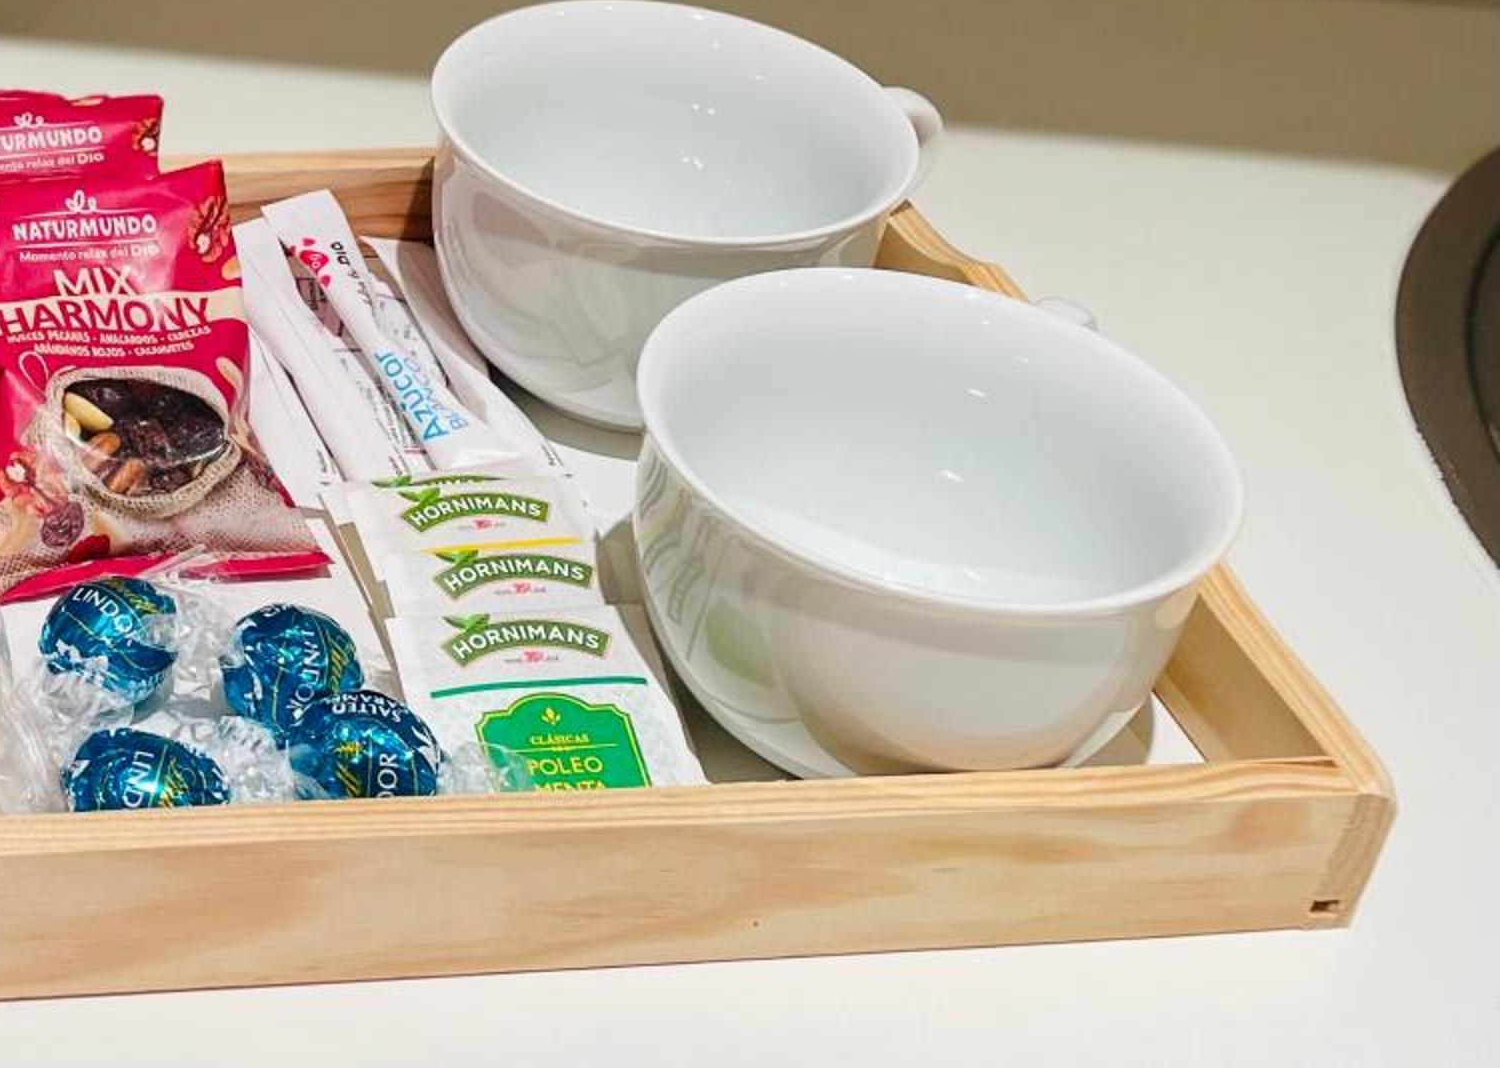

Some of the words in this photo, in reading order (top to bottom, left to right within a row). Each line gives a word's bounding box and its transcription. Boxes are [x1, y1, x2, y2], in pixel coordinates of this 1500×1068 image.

[12, 215, 157, 241] NATURMUNDO
[20, 250, 76, 263] Momento
[78, 248, 108, 260] relax
[53, 265, 139, 297] MIX
[409, 496, 542, 527] HORNIMANS
[443, 559, 585, 591] HORNIMANS
[452, 624, 600, 659] HORNIMANS
[331, 701, 401, 723] SALTED
[122, 750, 155, 809] LIND
[528, 755, 603, 776] POLEO
